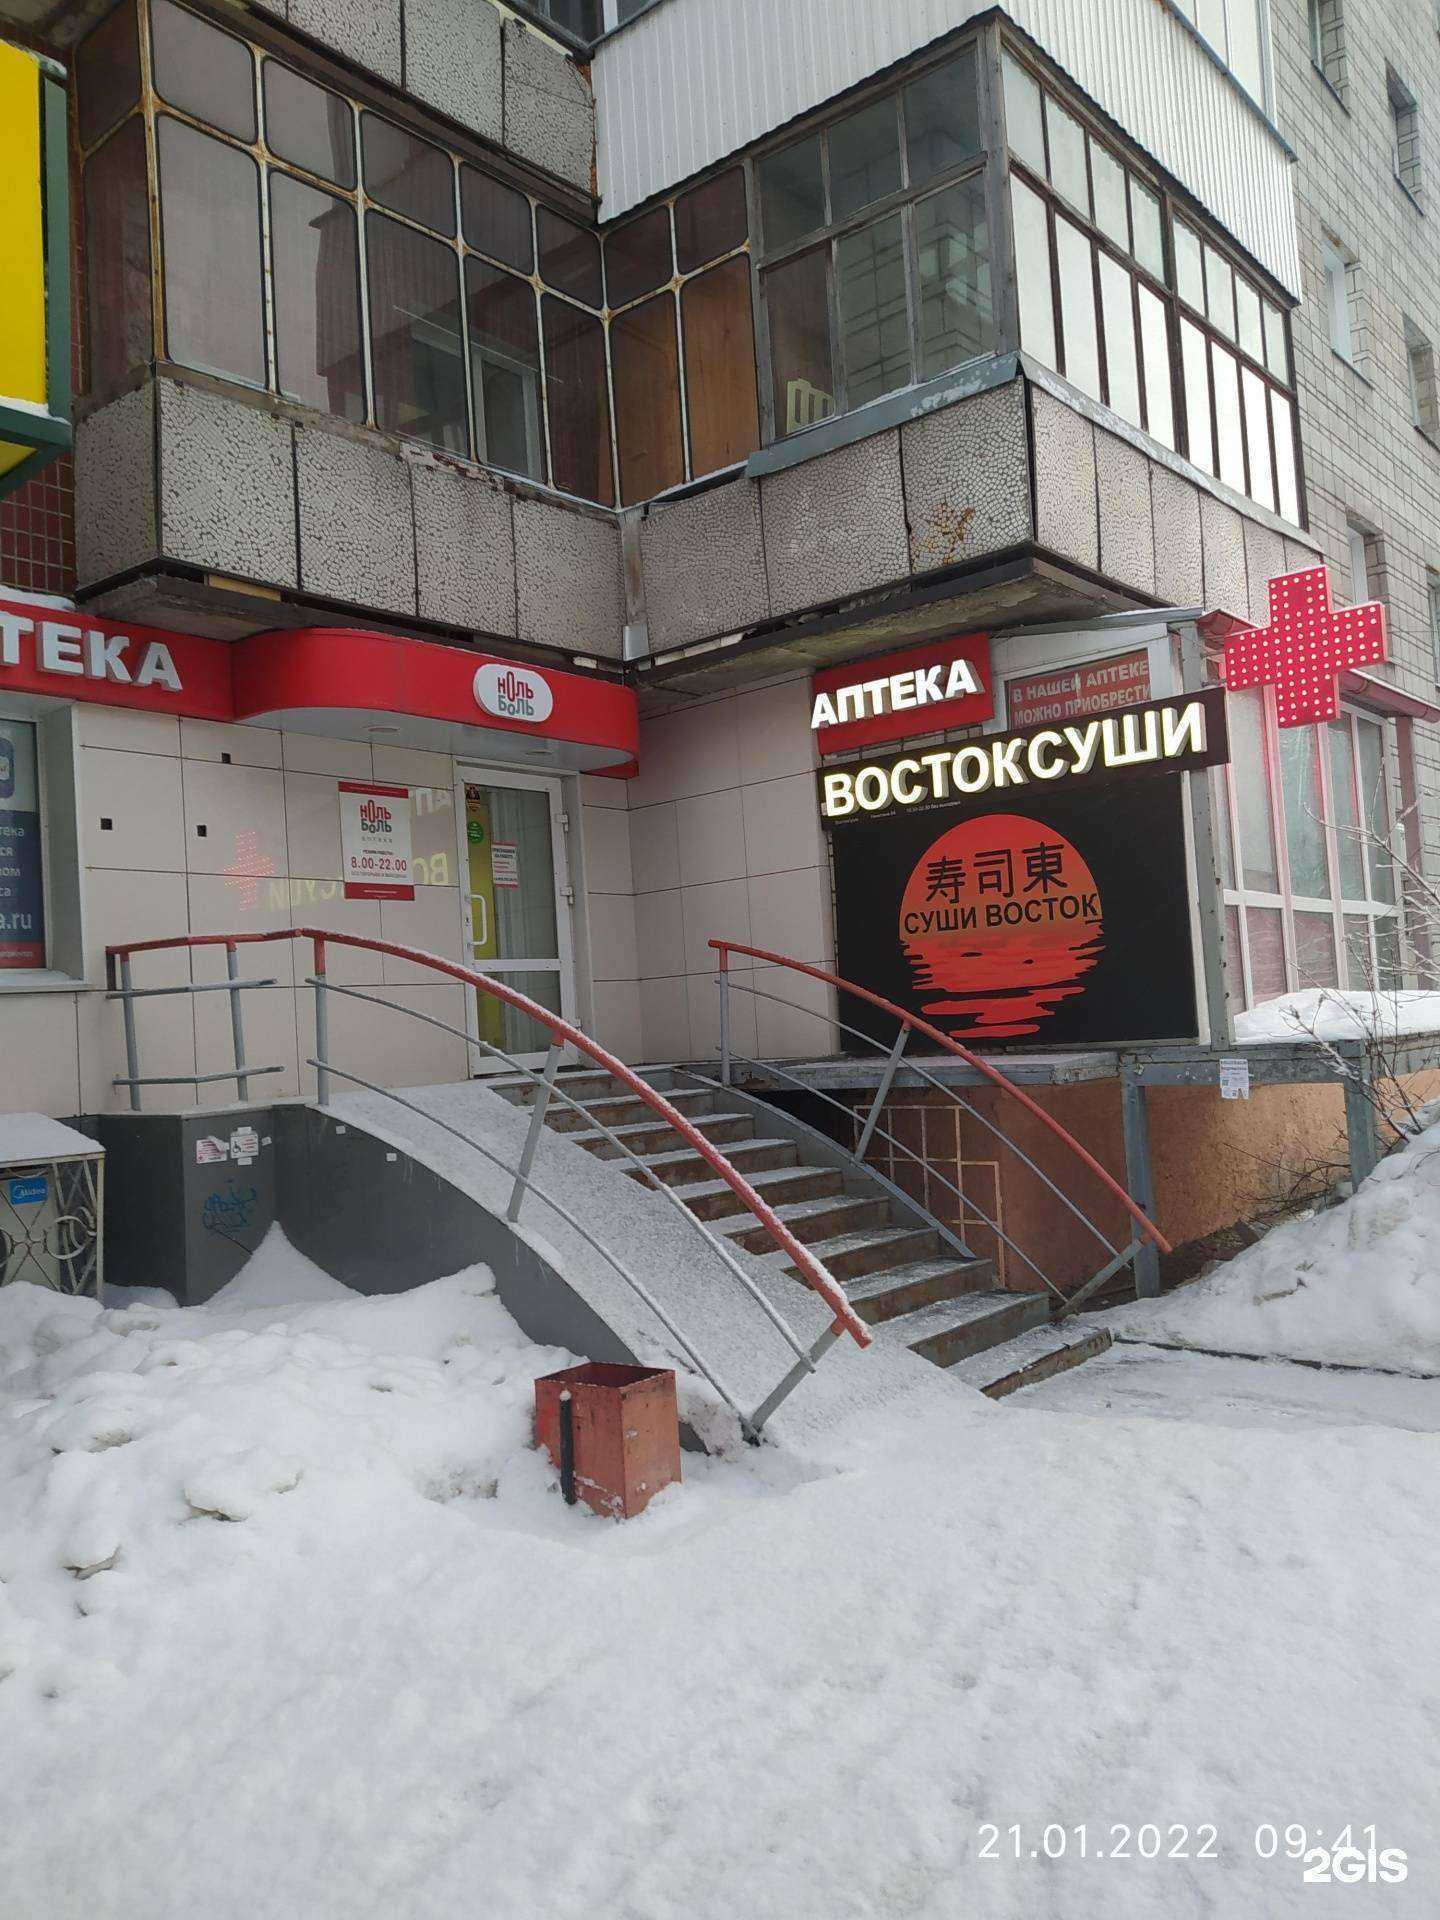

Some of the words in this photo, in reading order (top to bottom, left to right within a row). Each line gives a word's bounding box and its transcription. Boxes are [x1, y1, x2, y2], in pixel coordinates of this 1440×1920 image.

[0, 611, 183, 692] ТЕКА
[811, 659, 985, 729] АПТЕКА
[1013, 688, 1022, 703] В
[1027, 674, 1081, 700] НАШЕЙ
[1086, 660, 1148, 688] АПТЕКЕ
[1014, 703, 1061, 726] МОЖНО
[925, 841, 1068, 904] 寿司東
[904, 906, 977, 935] СУШИ
[986, 893, 1098, 928] ВОСТОК
